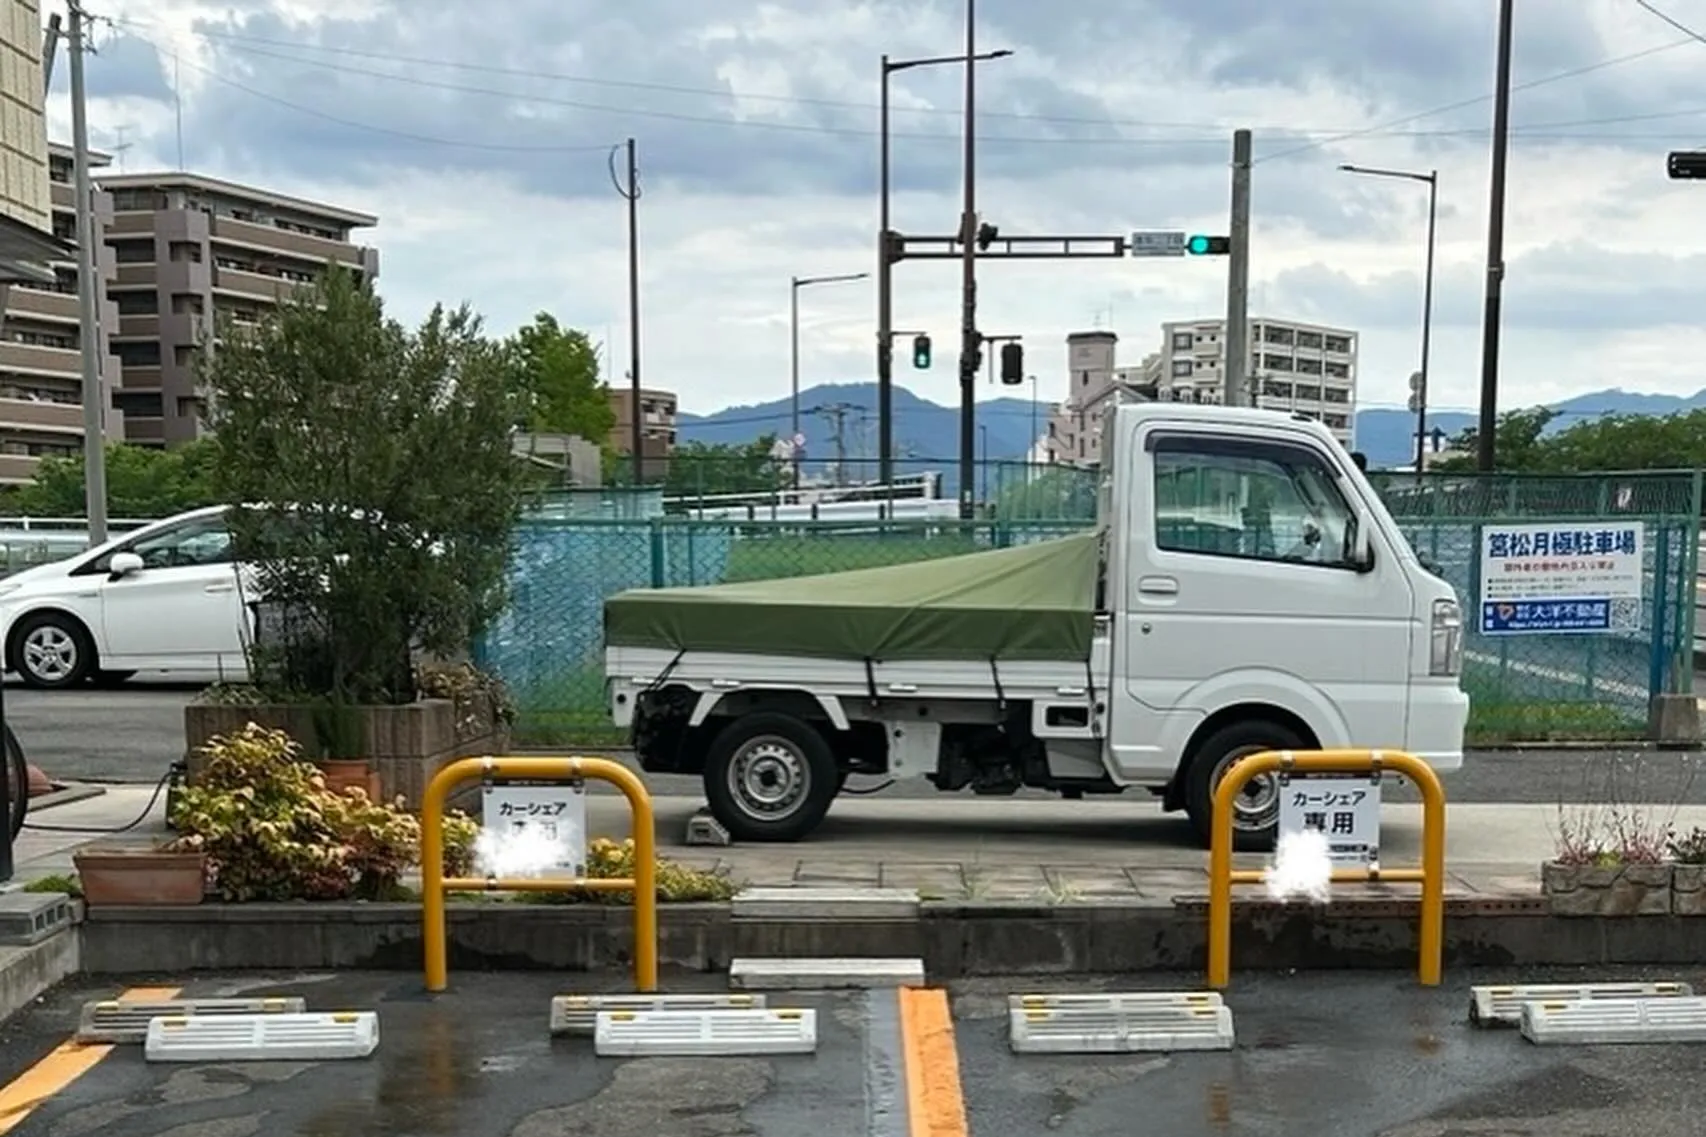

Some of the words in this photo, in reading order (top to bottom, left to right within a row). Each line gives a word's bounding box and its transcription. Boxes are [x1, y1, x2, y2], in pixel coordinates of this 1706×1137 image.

[1293, 791, 1366, 807] カーシェア
[499, 801, 567, 816] カーシェア
[1303, 812, 1354, 835] 専用
